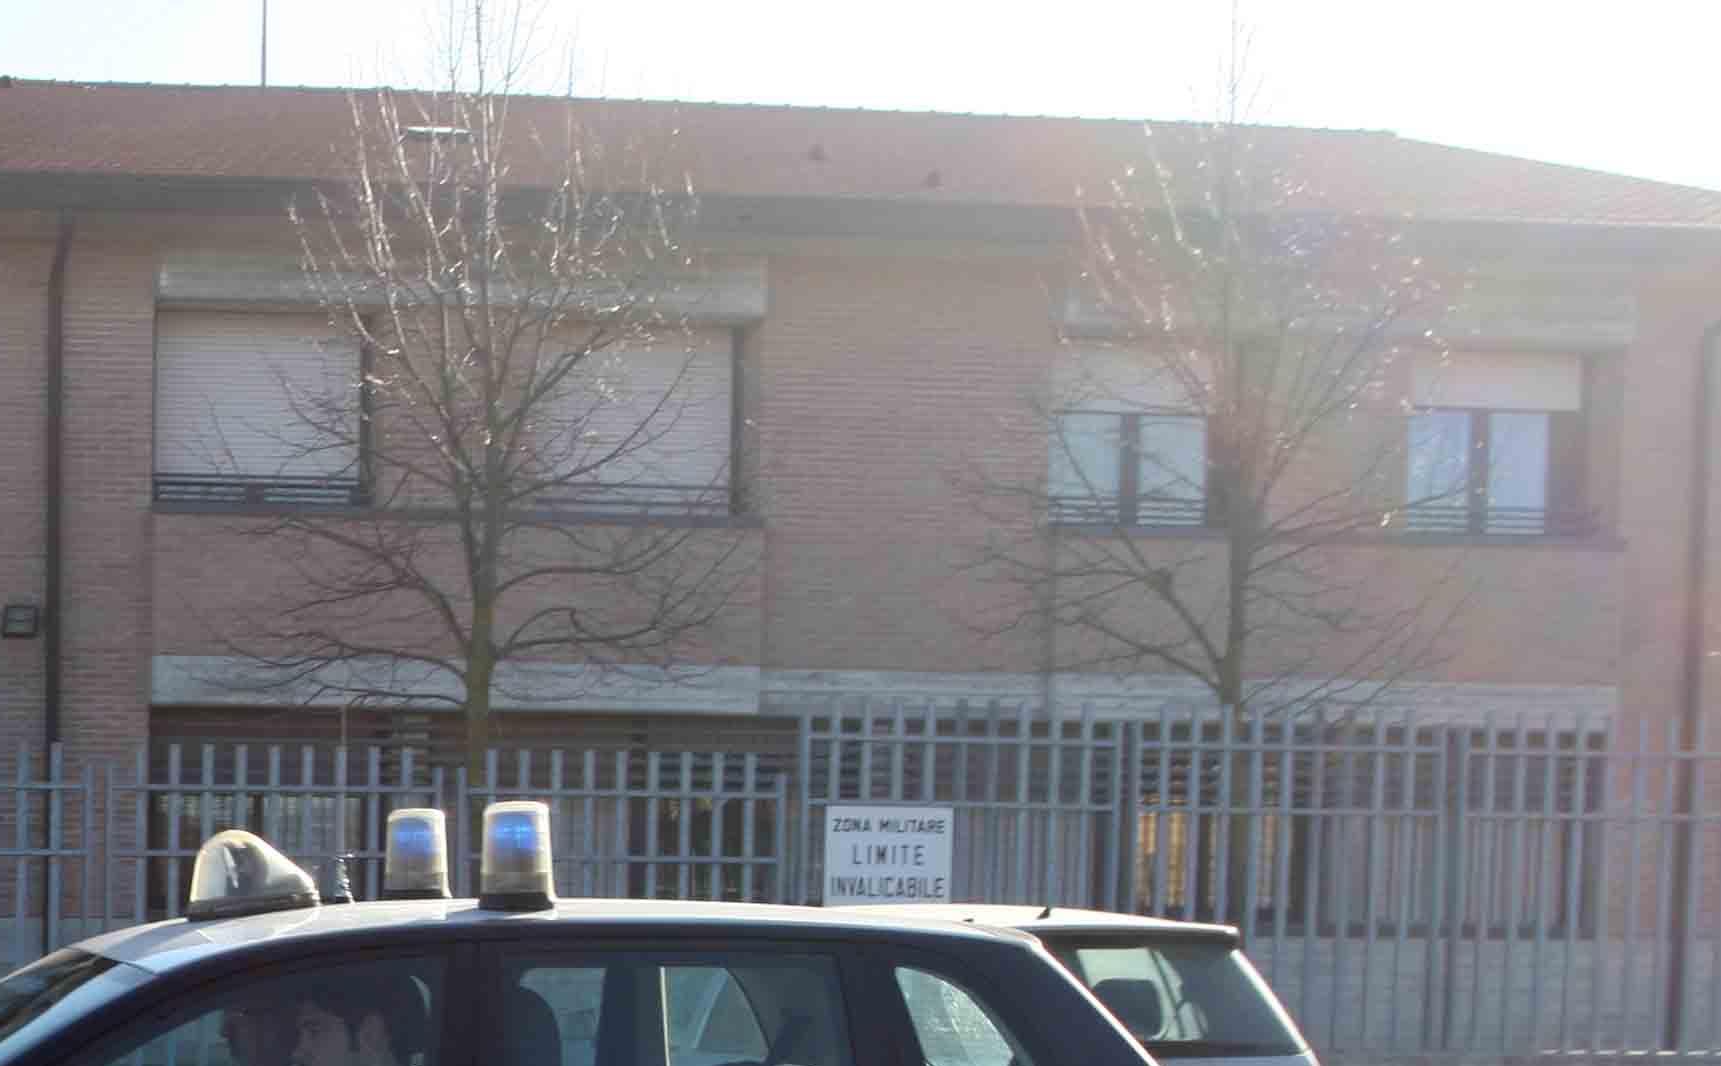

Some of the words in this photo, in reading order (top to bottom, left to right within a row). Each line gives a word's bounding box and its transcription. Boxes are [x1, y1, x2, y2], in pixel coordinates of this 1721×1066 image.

[832, 817, 871, 833] ZONA
[879, 818, 945, 834] MILITARE
[851, 843, 925, 866] LIMITE
[831, 876, 945, 898] INVALICABILE
